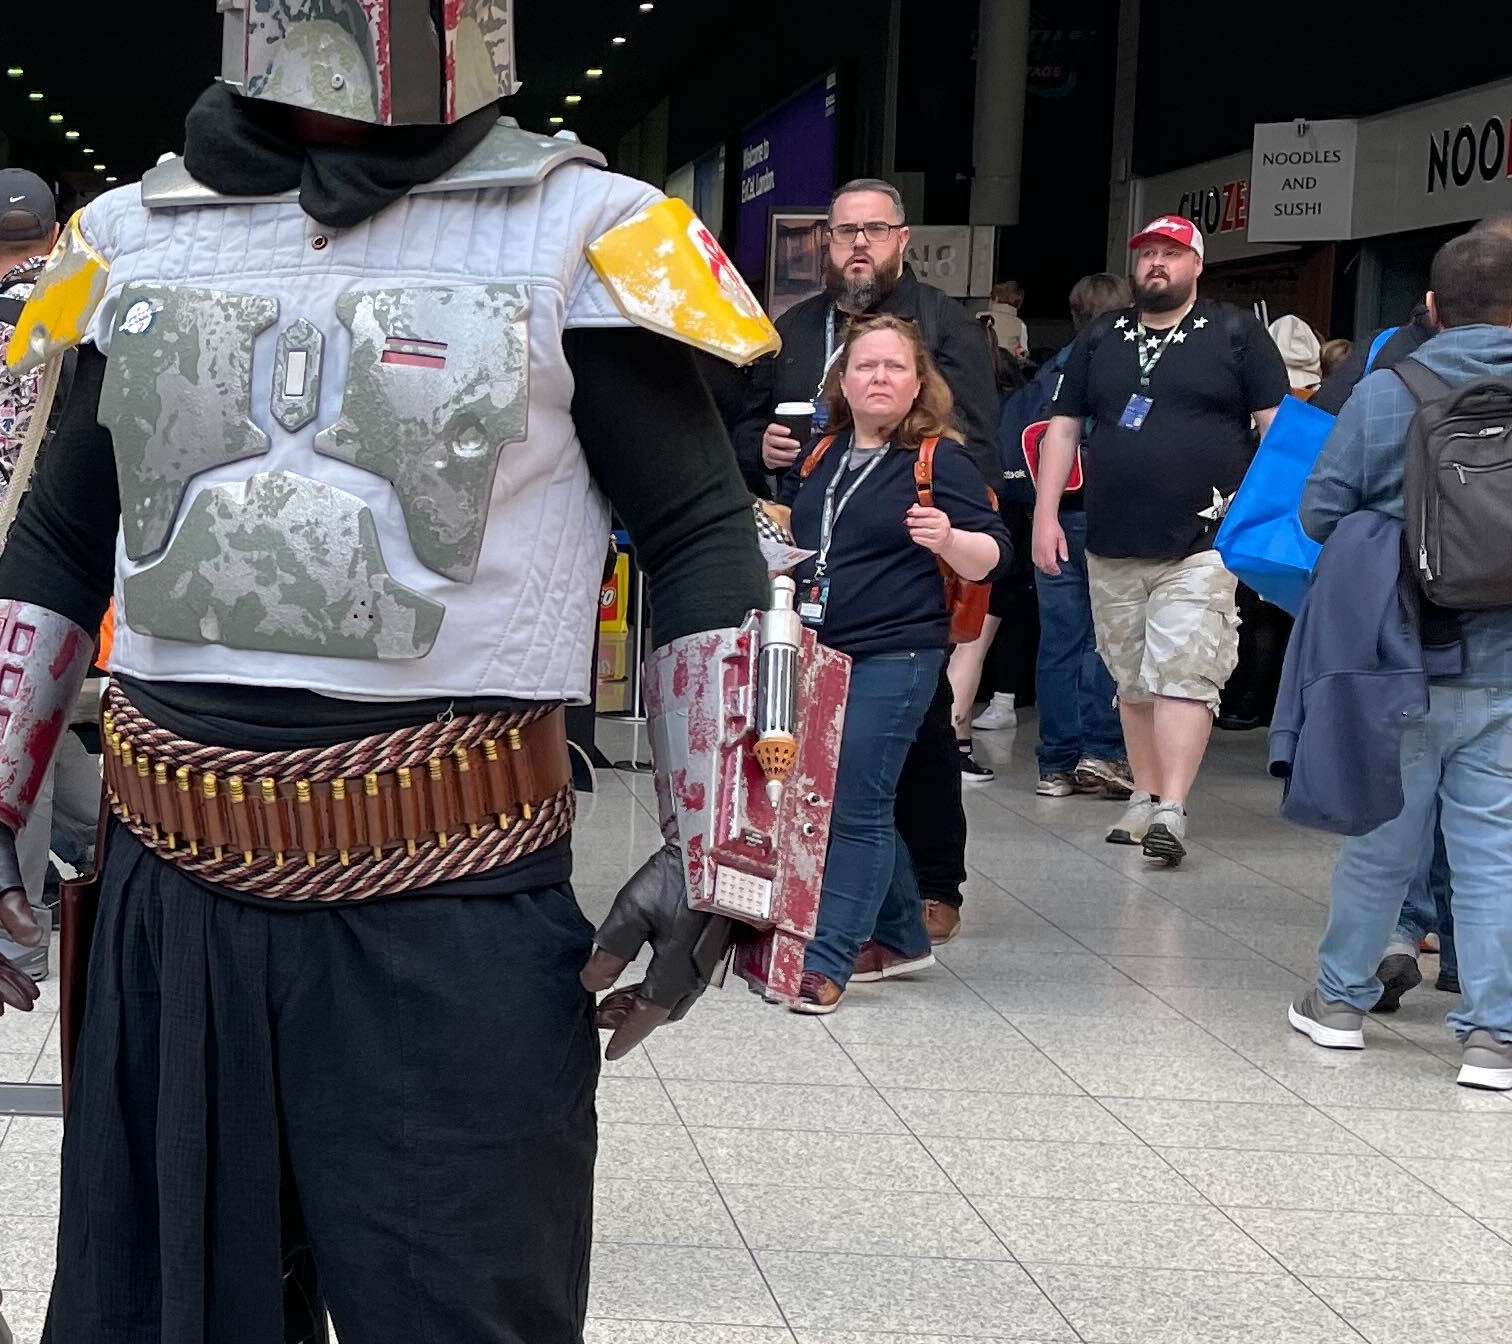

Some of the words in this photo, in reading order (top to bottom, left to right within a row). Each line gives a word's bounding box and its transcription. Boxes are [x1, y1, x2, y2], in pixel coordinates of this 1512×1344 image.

[1262, 149, 1342, 167] NOODLES
[1426, 113, 1512, 196] NOO
[1281, 176, 1318, 192] AND
[1273, 201, 1323, 217] SUSHI
